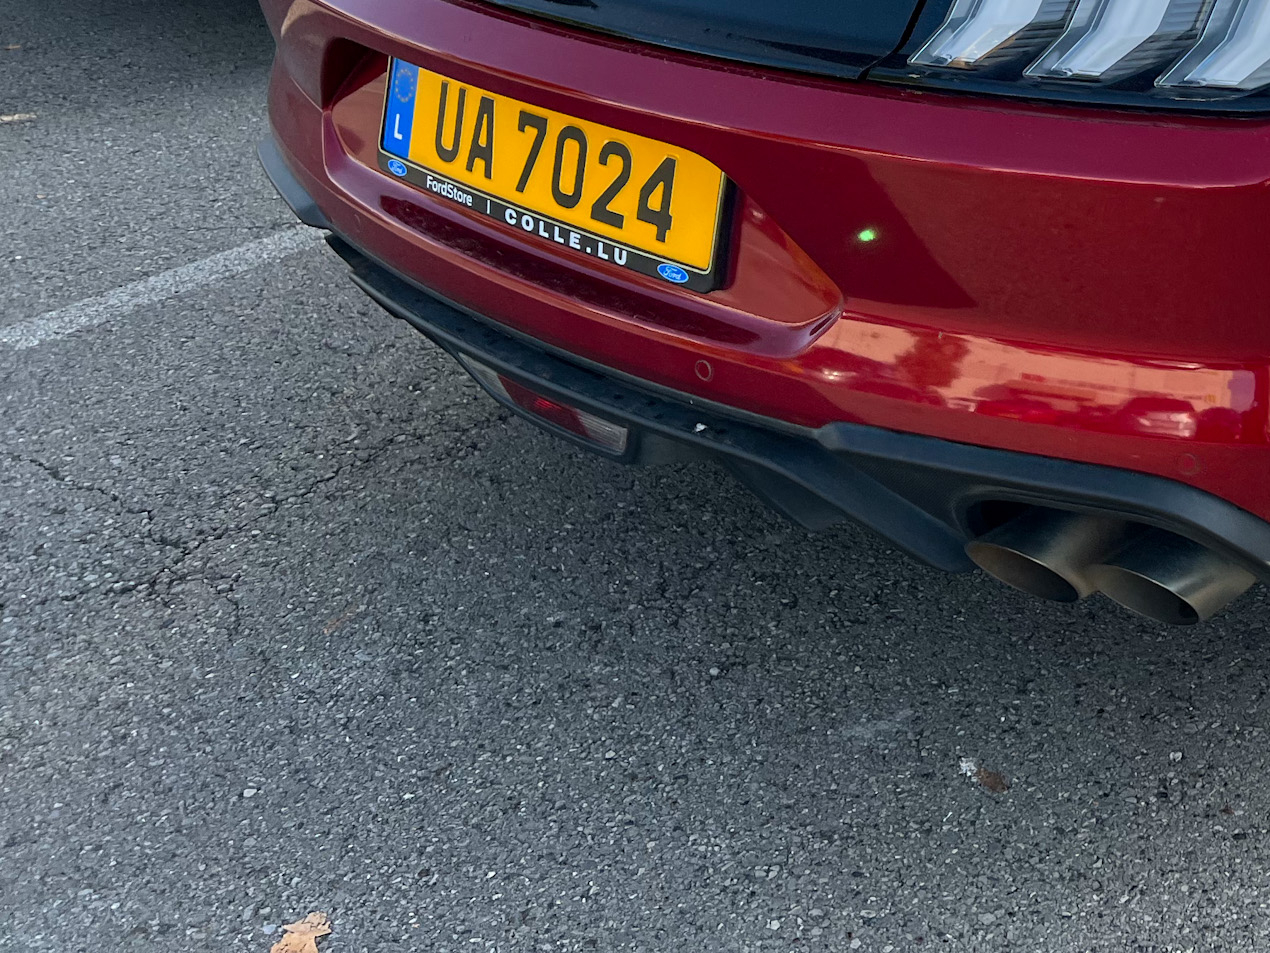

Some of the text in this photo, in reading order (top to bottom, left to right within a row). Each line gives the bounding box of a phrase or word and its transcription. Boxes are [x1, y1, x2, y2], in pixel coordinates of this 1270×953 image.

[393, 80, 677, 243] L UA 7024
[426, 175, 473, 207] FordStore
[504, 208, 628, 266] COLLE.LU
[660, 265, 686, 282] Ford
